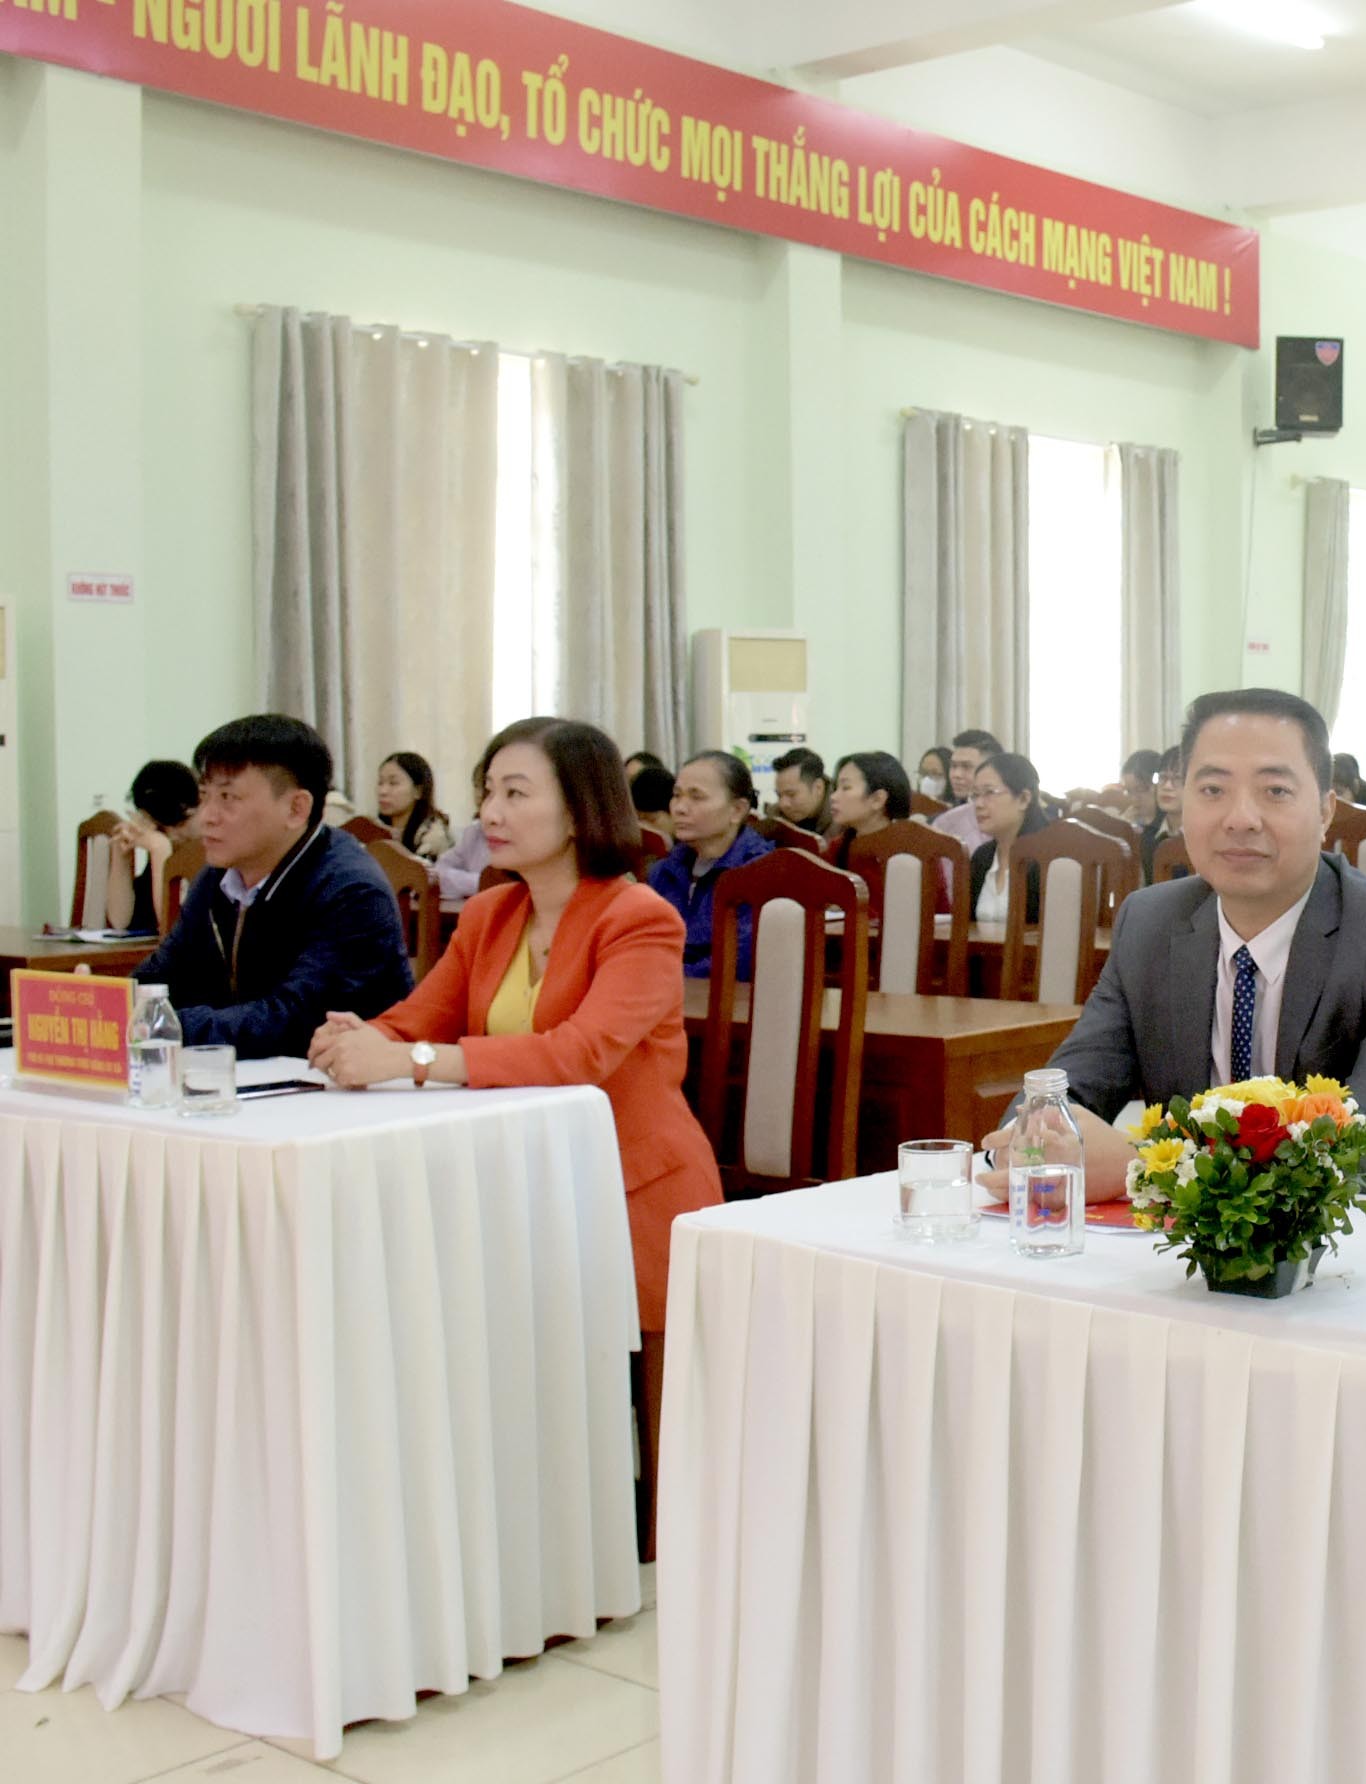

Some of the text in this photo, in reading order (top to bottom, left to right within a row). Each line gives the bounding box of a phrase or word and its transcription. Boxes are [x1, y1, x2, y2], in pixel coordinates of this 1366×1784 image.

[296, 1, 409, 106] LÃNH
[420, 41, 511, 141] ĐẠO,
[521, 53, 569, 146] TỔ
[577, 88, 672, 173] CHỨC
[680, 115, 743, 203] MỌI
[751, 125, 850, 220] THẮNG
[857, 165, 901, 243] LỢI
[908, 167, 963, 249] CỦA
[968, 191, 1036, 268] CÁCH
[1042, 216, 1113, 289] MẠNG
[1117, 232, 1165, 307] VIỆT
[1169, 252, 1219, 313] NAM
